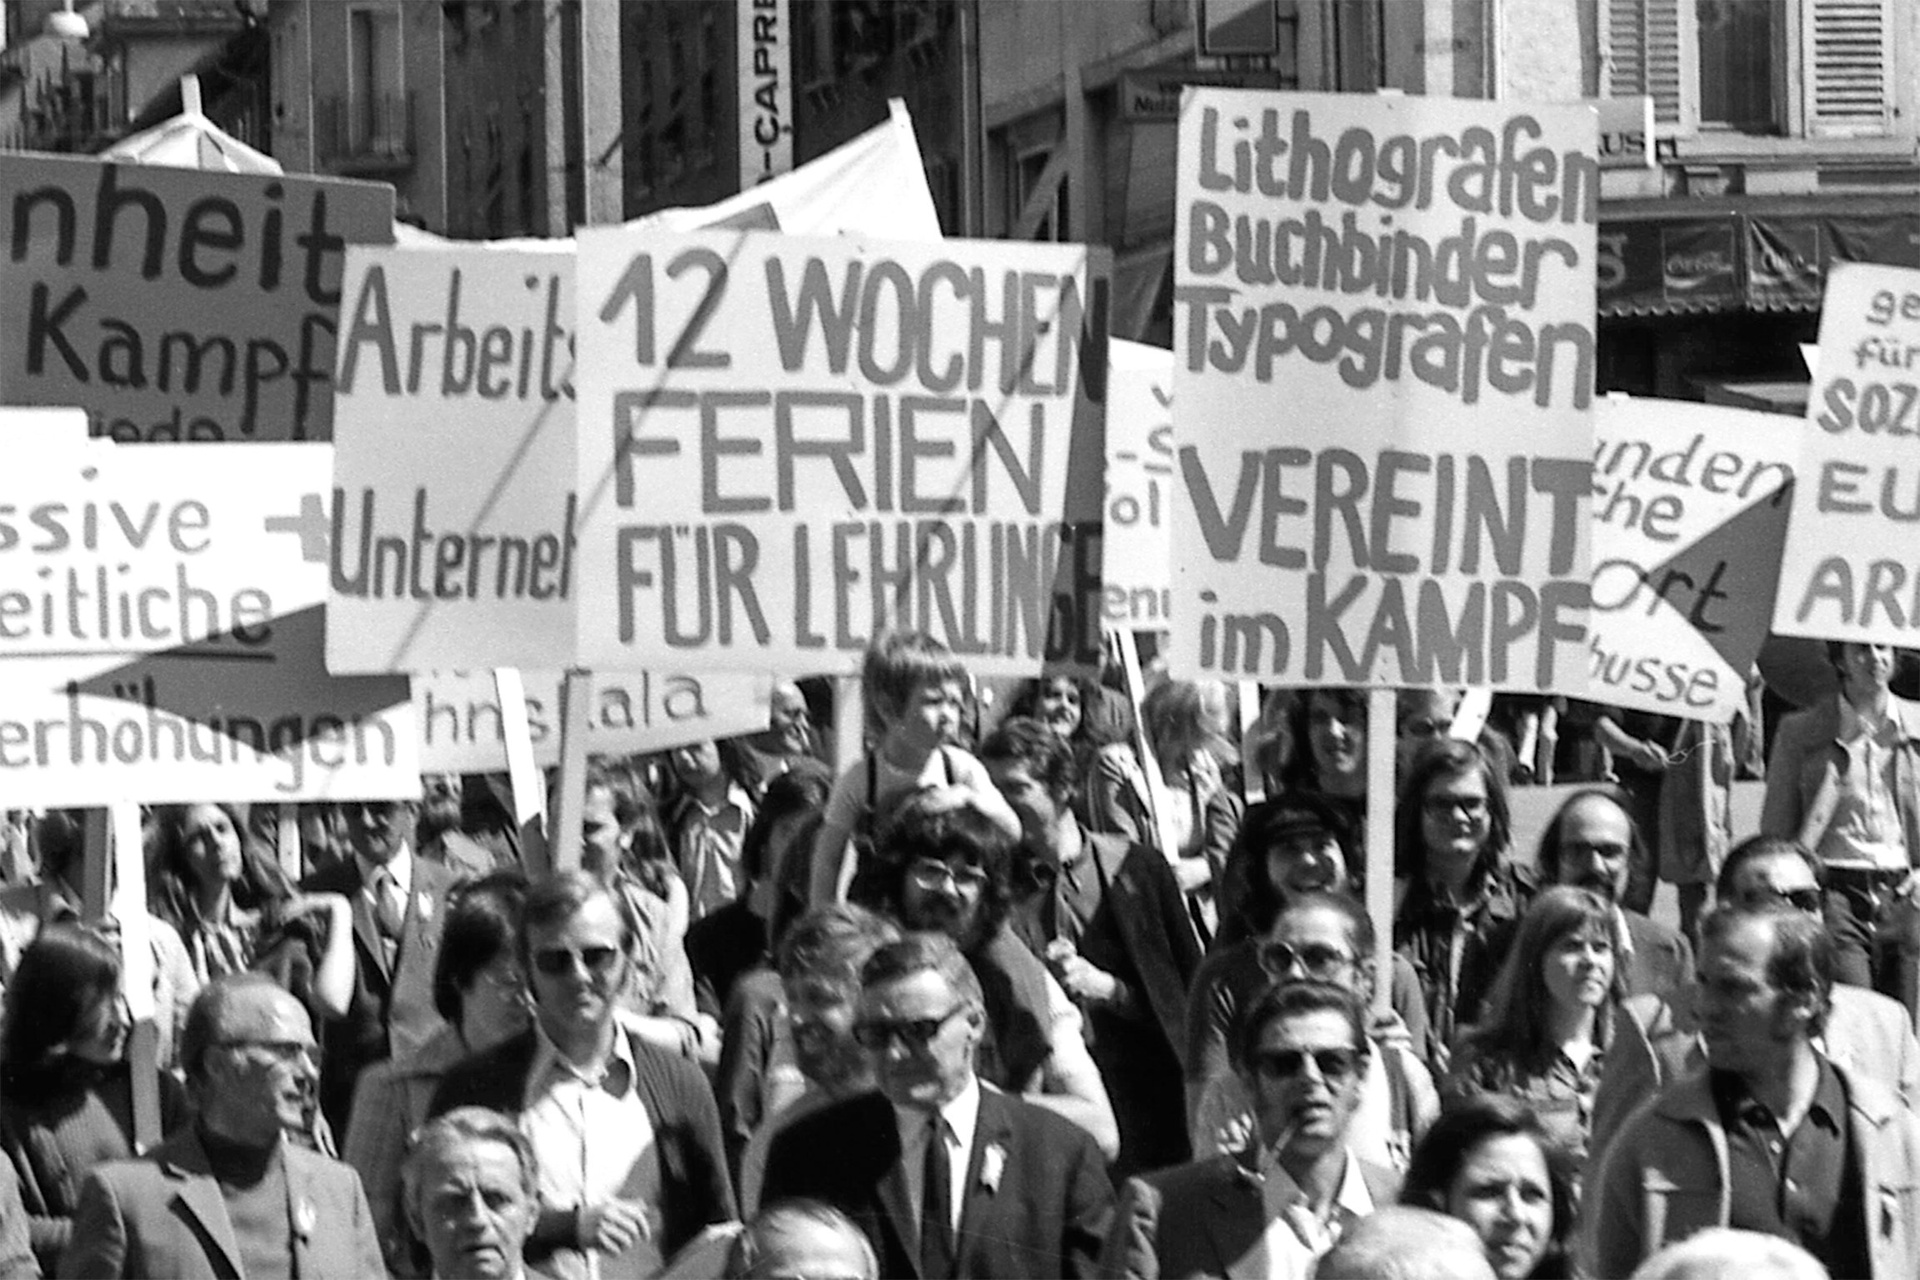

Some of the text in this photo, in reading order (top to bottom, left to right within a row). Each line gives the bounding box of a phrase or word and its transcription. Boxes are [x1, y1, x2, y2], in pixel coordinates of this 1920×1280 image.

[1198, 106, 1598, 224] Lithografen
[10, 160, 343, 305] nheit
[1188, 199, 1579, 310] Buchbinder
[26, 281, 337, 441] Kampf
[335, 264, 577, 401] Arbeit
[600, 248, 1110, 404] 12 WOCHEN
[1175, 284, 1593, 410] Typografen
[612, 390, 1044, 516] FERIEN
[1178, 444, 1596, 577] VEREINT
[616, 519, 1102, 666] FÜR LEHRLINGE
[1199, 572, 1593, 691] im KAMPF
[1796, 557, 1920, 629] AR
